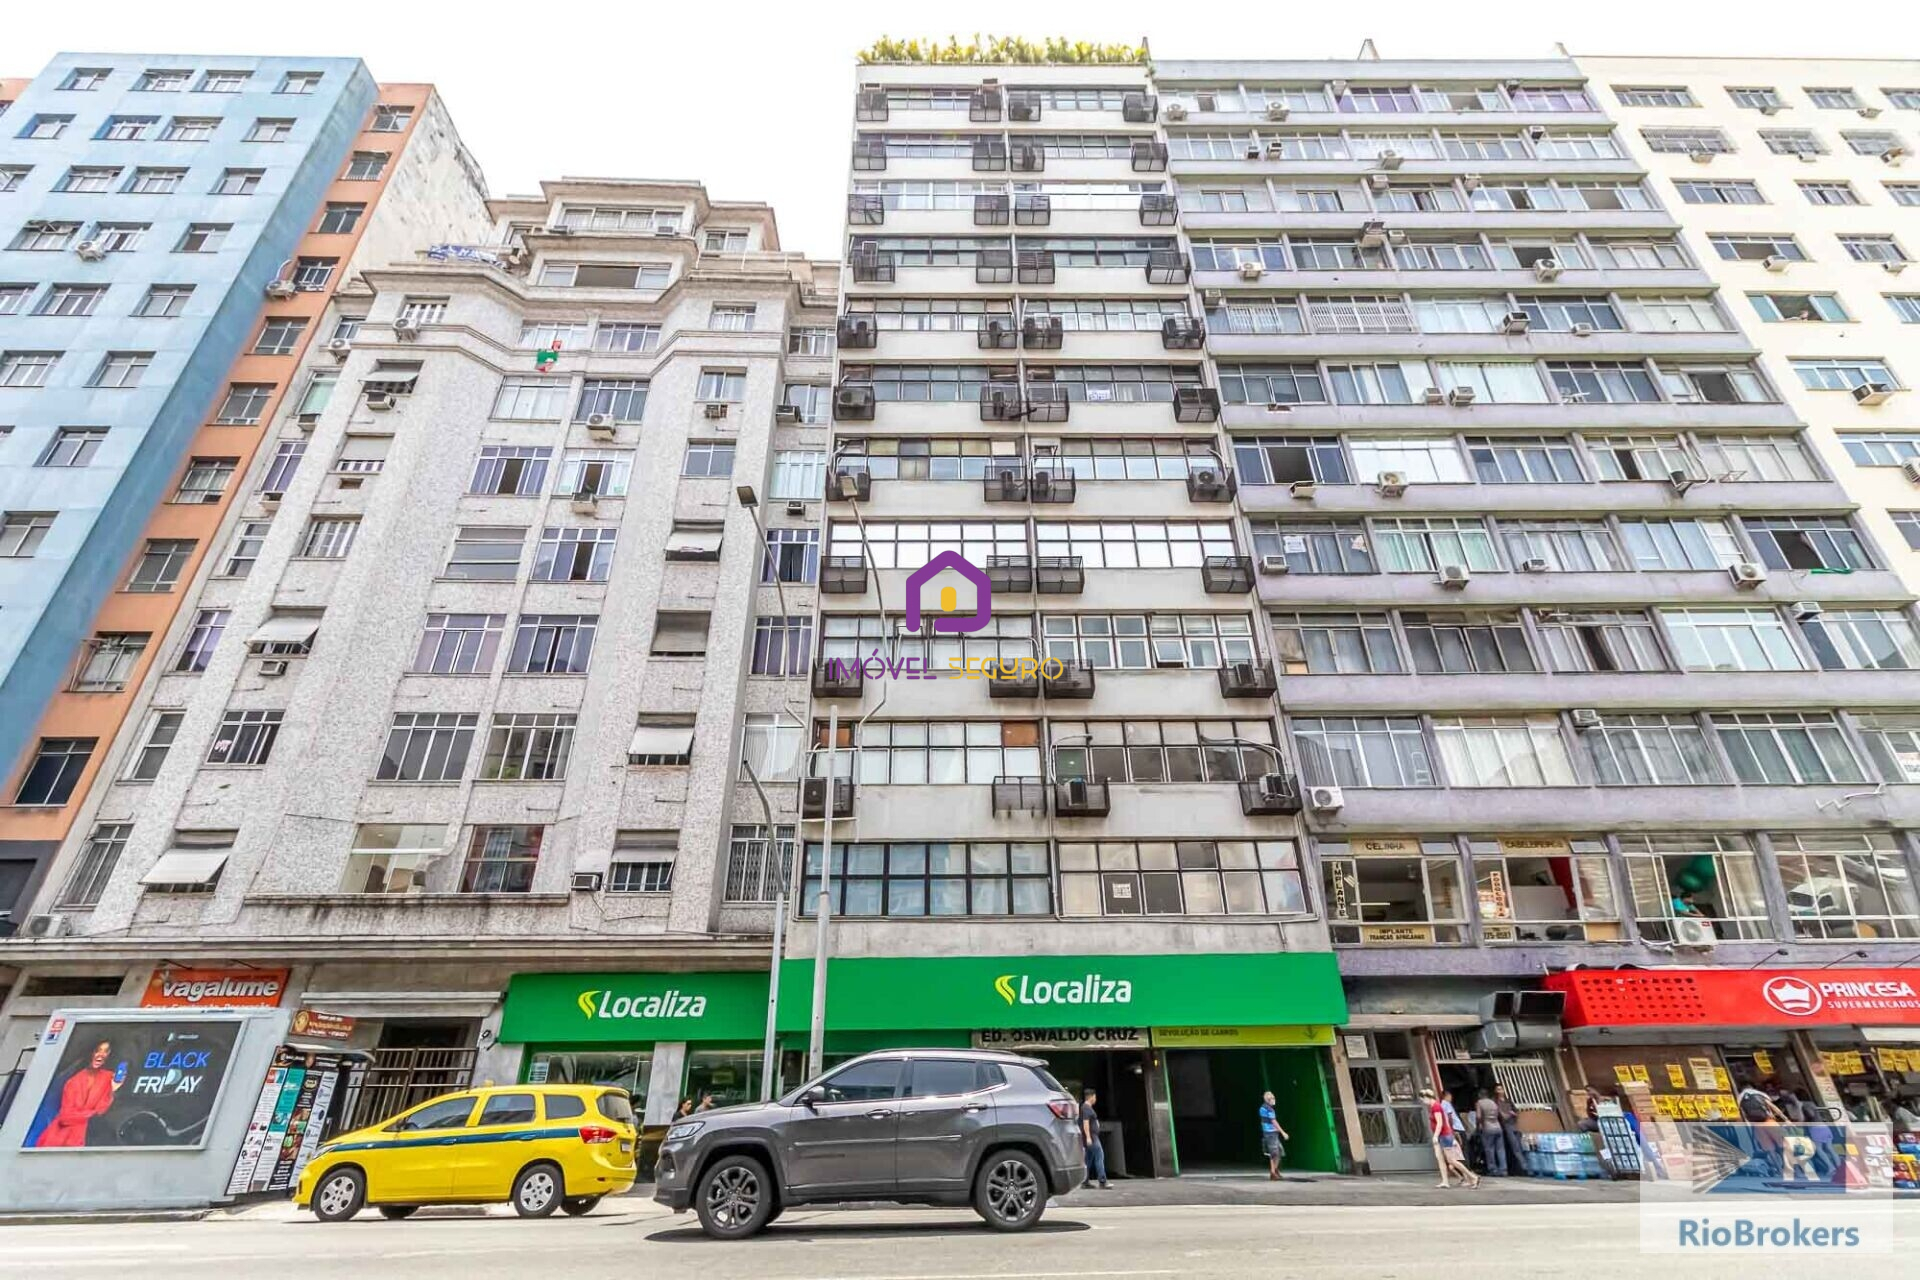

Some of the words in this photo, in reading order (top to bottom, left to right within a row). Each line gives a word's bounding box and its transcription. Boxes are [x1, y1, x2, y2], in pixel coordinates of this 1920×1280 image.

[1333, 861, 1346, 917] IMPLANTE
[1019, 974, 1132, 1004] Localiza
[1818, 981, 1917, 998] PRINCESA
[598, 990, 707, 1019] Localiza
[1012, 1028, 1090, 1042] OSWALDO
[1094, 1027, 1139, 1041] CRUZ
[143, 1051, 212, 1069] BLACK
